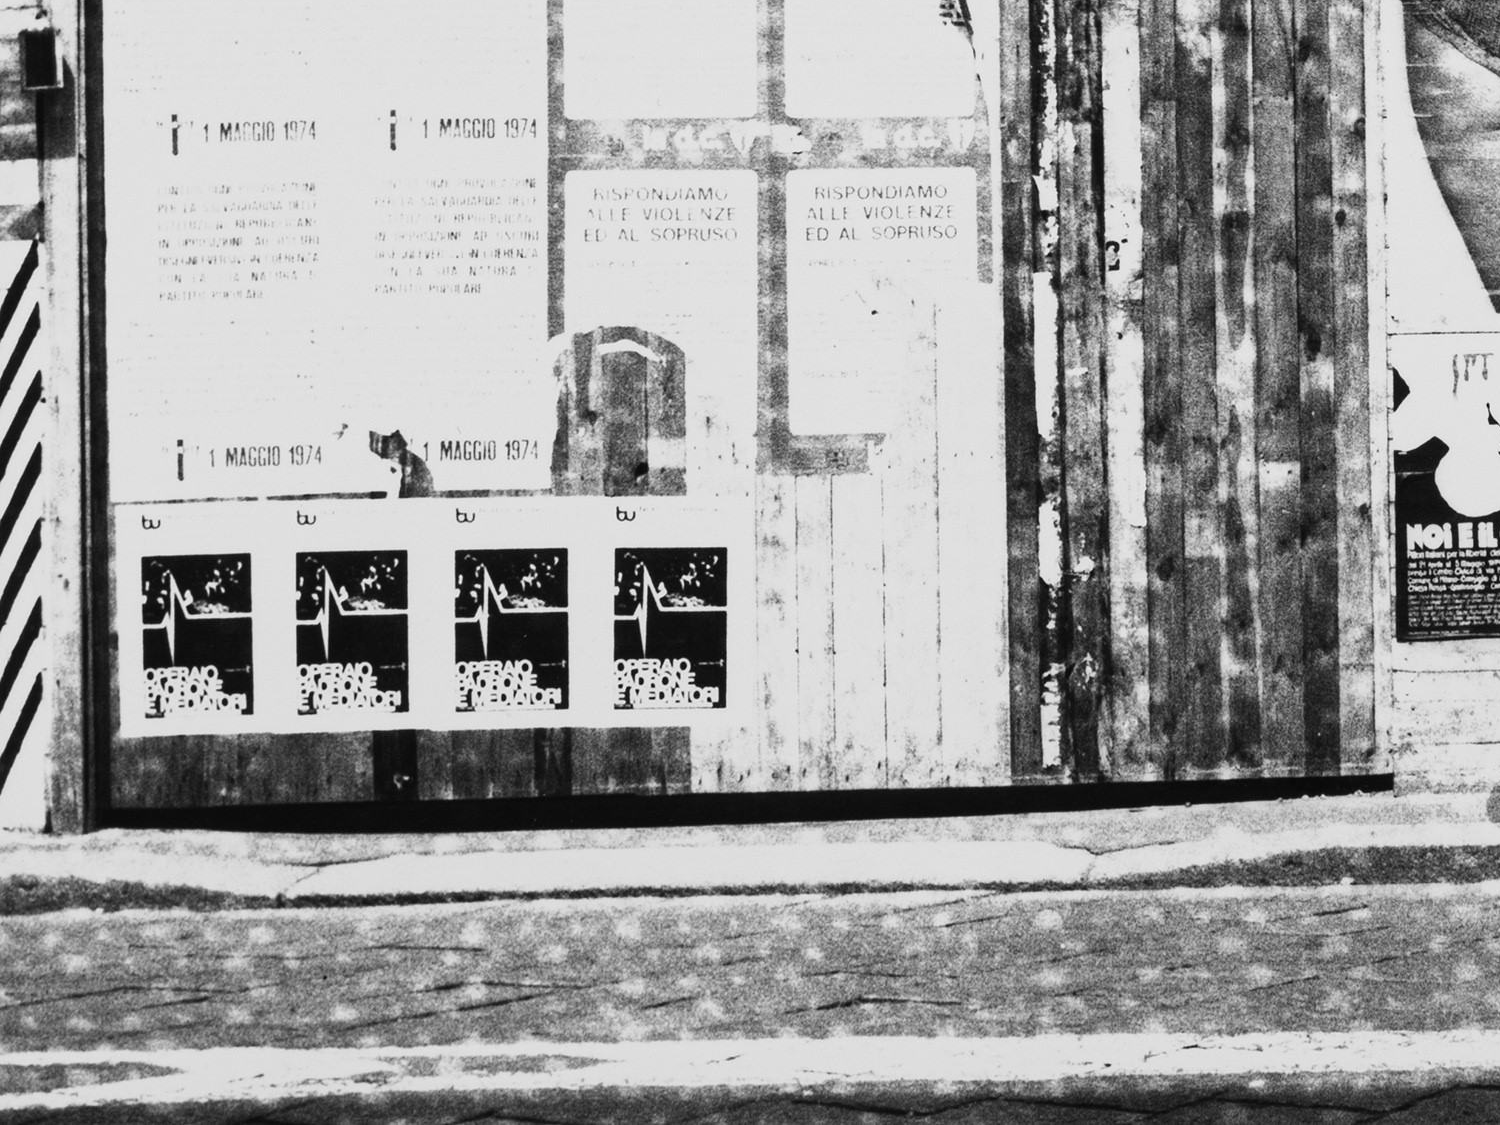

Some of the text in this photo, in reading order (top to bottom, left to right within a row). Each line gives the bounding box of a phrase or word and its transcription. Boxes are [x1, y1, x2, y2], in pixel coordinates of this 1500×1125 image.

[203, 120, 316, 143] 1 MAGGIO 1974
[422, 117, 537, 139] 1 MAGGIO 1974
[593, 187, 728, 202] RISPONDIAMO
[815, 185, 948, 200] RISPONDIAMO
[586, 207, 735, 222] ALLE VIOLENZE
[807, 204, 956, 221] ALLE VIOLENZE
[584, 227, 737, 243] ED AL SOPRUSO
[806, 224, 958, 242] ED AL SOPRUSO
[209, 444, 322, 468] 1 MAGGIO 1974
[422, 439, 539, 462] 1 MAGGIO 1974
[1458, 522, 1474, 548] E
